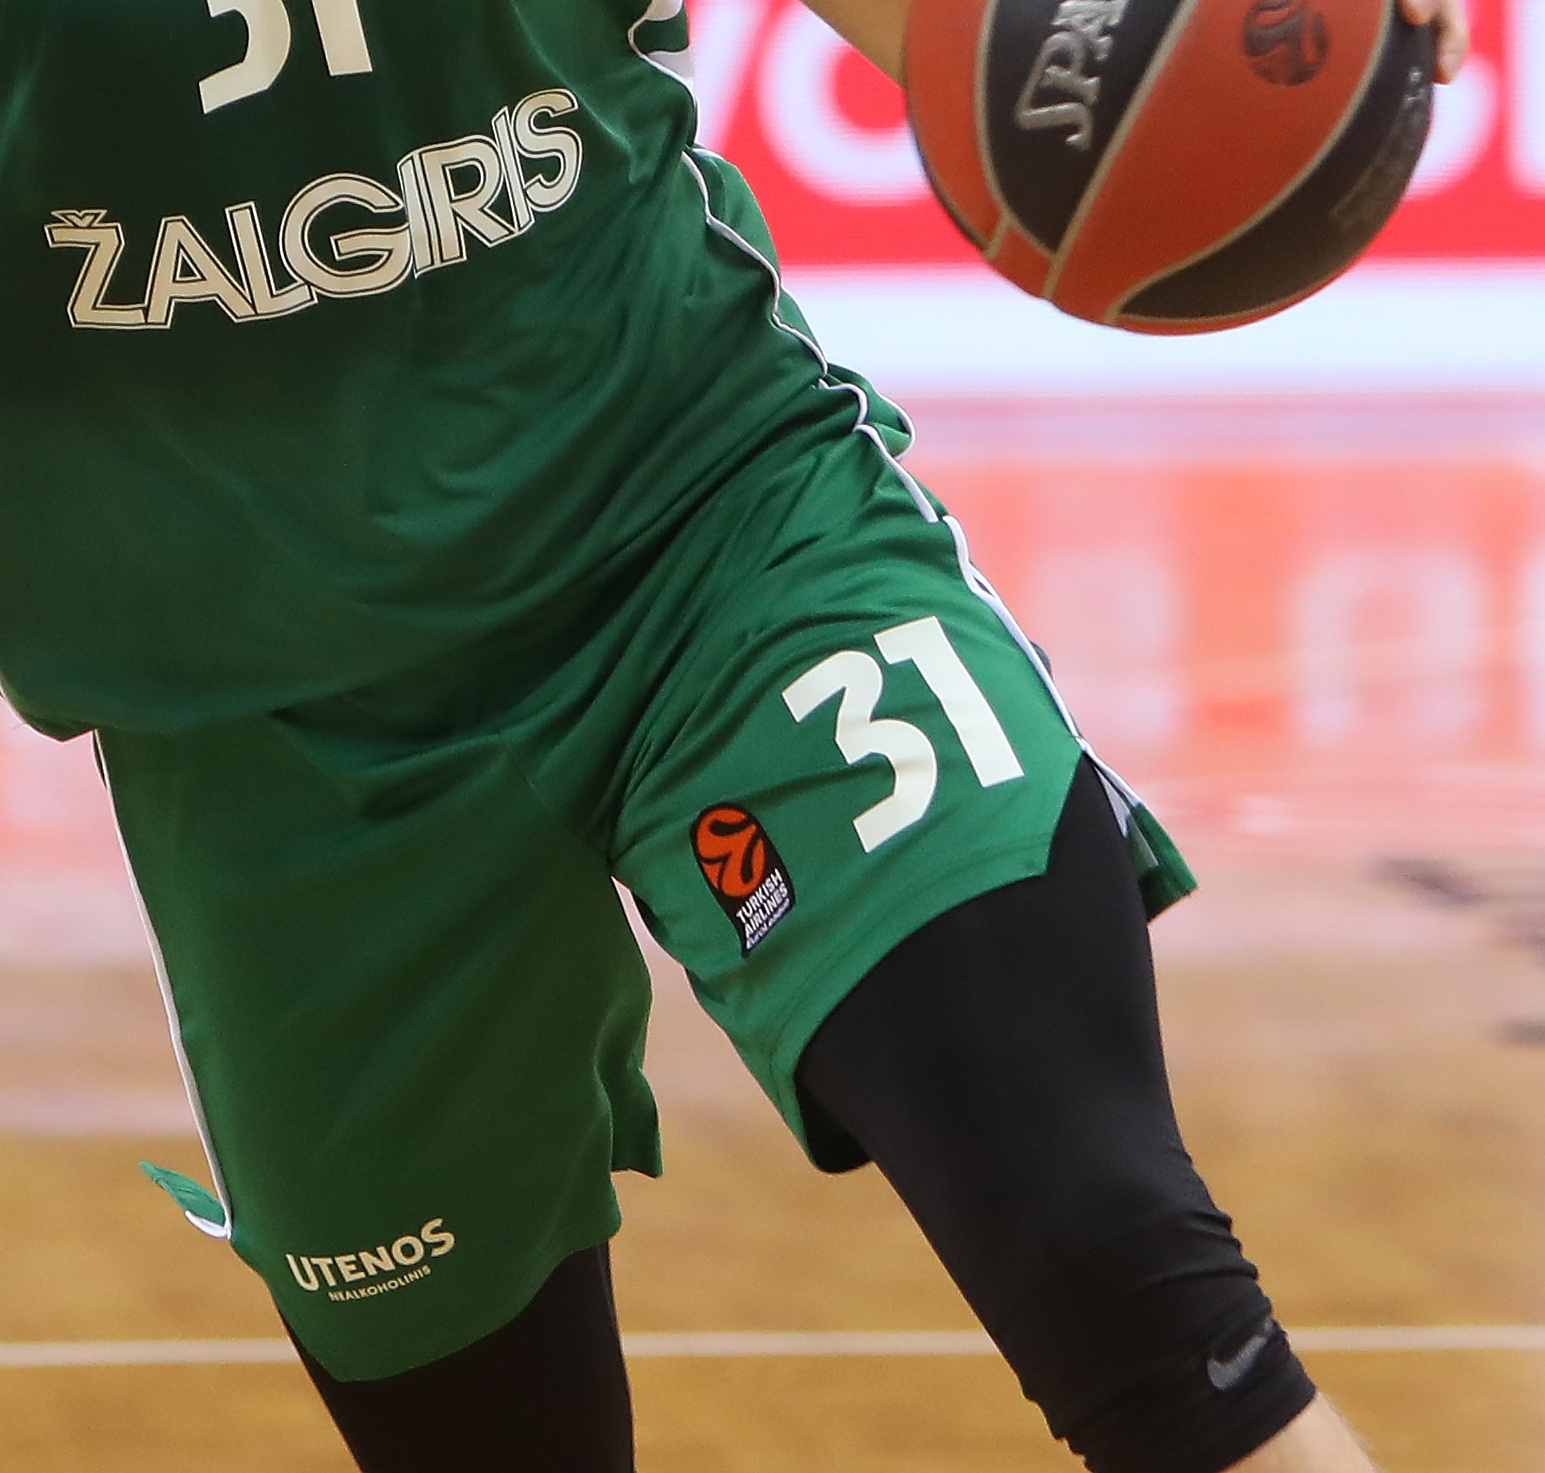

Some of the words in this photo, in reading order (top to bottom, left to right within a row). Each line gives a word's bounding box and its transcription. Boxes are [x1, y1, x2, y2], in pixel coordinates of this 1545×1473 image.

[44, 88, 585, 330] ŽALGIRIS
[781, 615, 1026, 854] 31
[735, 867, 784, 924] TURKISH
[744, 882, 789, 939] AIRLINES
[285, 1218, 456, 1292] UTENOS
